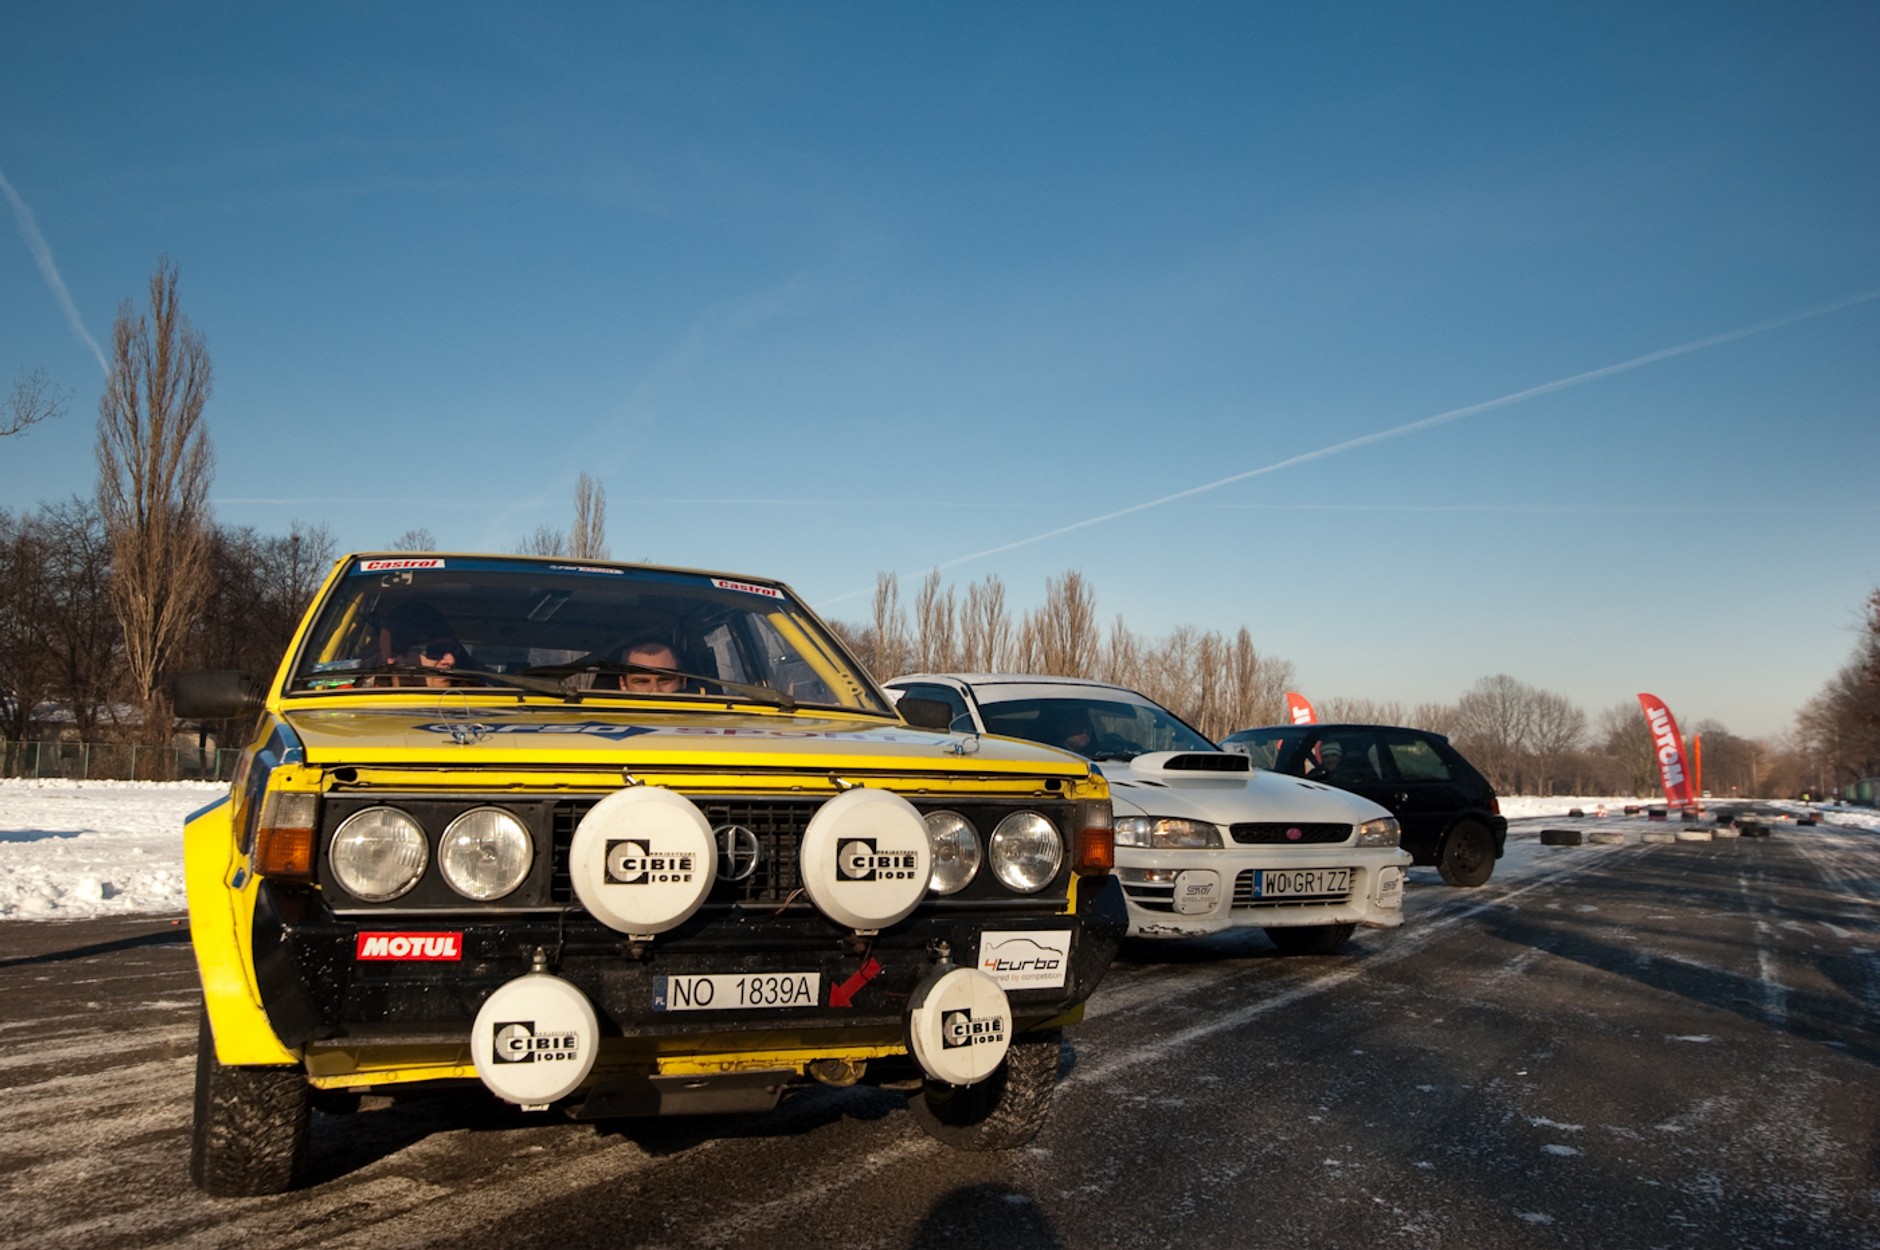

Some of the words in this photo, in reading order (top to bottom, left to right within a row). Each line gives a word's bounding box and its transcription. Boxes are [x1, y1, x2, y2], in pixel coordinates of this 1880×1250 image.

[367, 560, 438, 570] Castrol
[718, 581, 777, 596] Castrol
[651, 874, 692, 883] IODE
[879, 871, 915, 879] IODE
[361, 937, 458, 957] MOTUL
[984, 957, 1060, 972] 4turbo
[1011, 973, 1020, 982] by
[655, 996, 665, 1006] PL
[673, 978, 714, 1006] NO
[735, 976, 812, 1005] 1839A
[973, 1034, 1003, 1045] IODE
[537, 1052, 577, 1062] IODE
